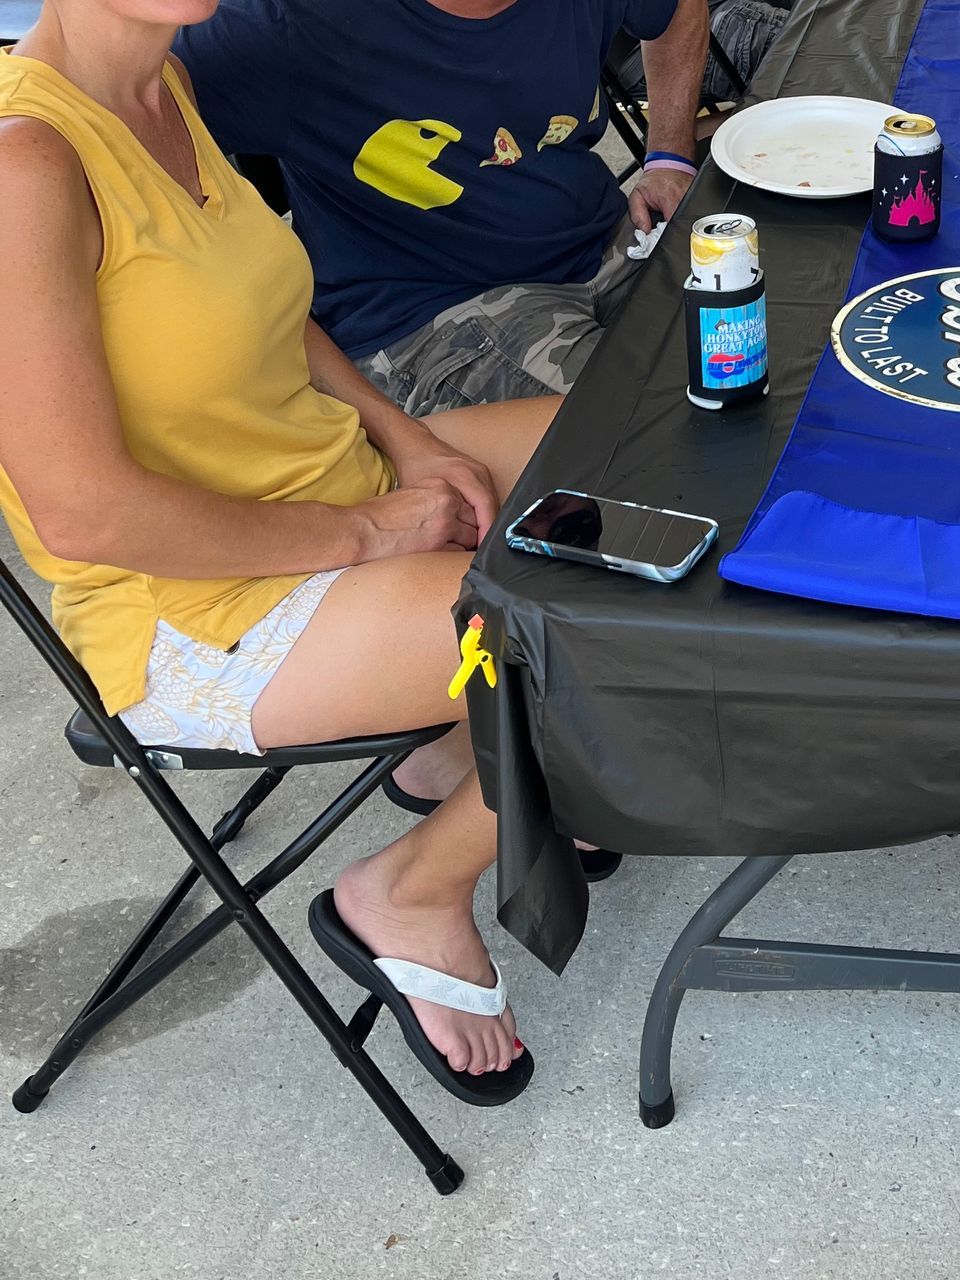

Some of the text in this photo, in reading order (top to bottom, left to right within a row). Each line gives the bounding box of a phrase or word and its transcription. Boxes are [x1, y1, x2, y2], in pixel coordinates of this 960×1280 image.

[718, 314, 760, 334] MAKING
[854, 288, 929, 383] BUILT TO LAST
[704, 341, 744, 353] GREAT
